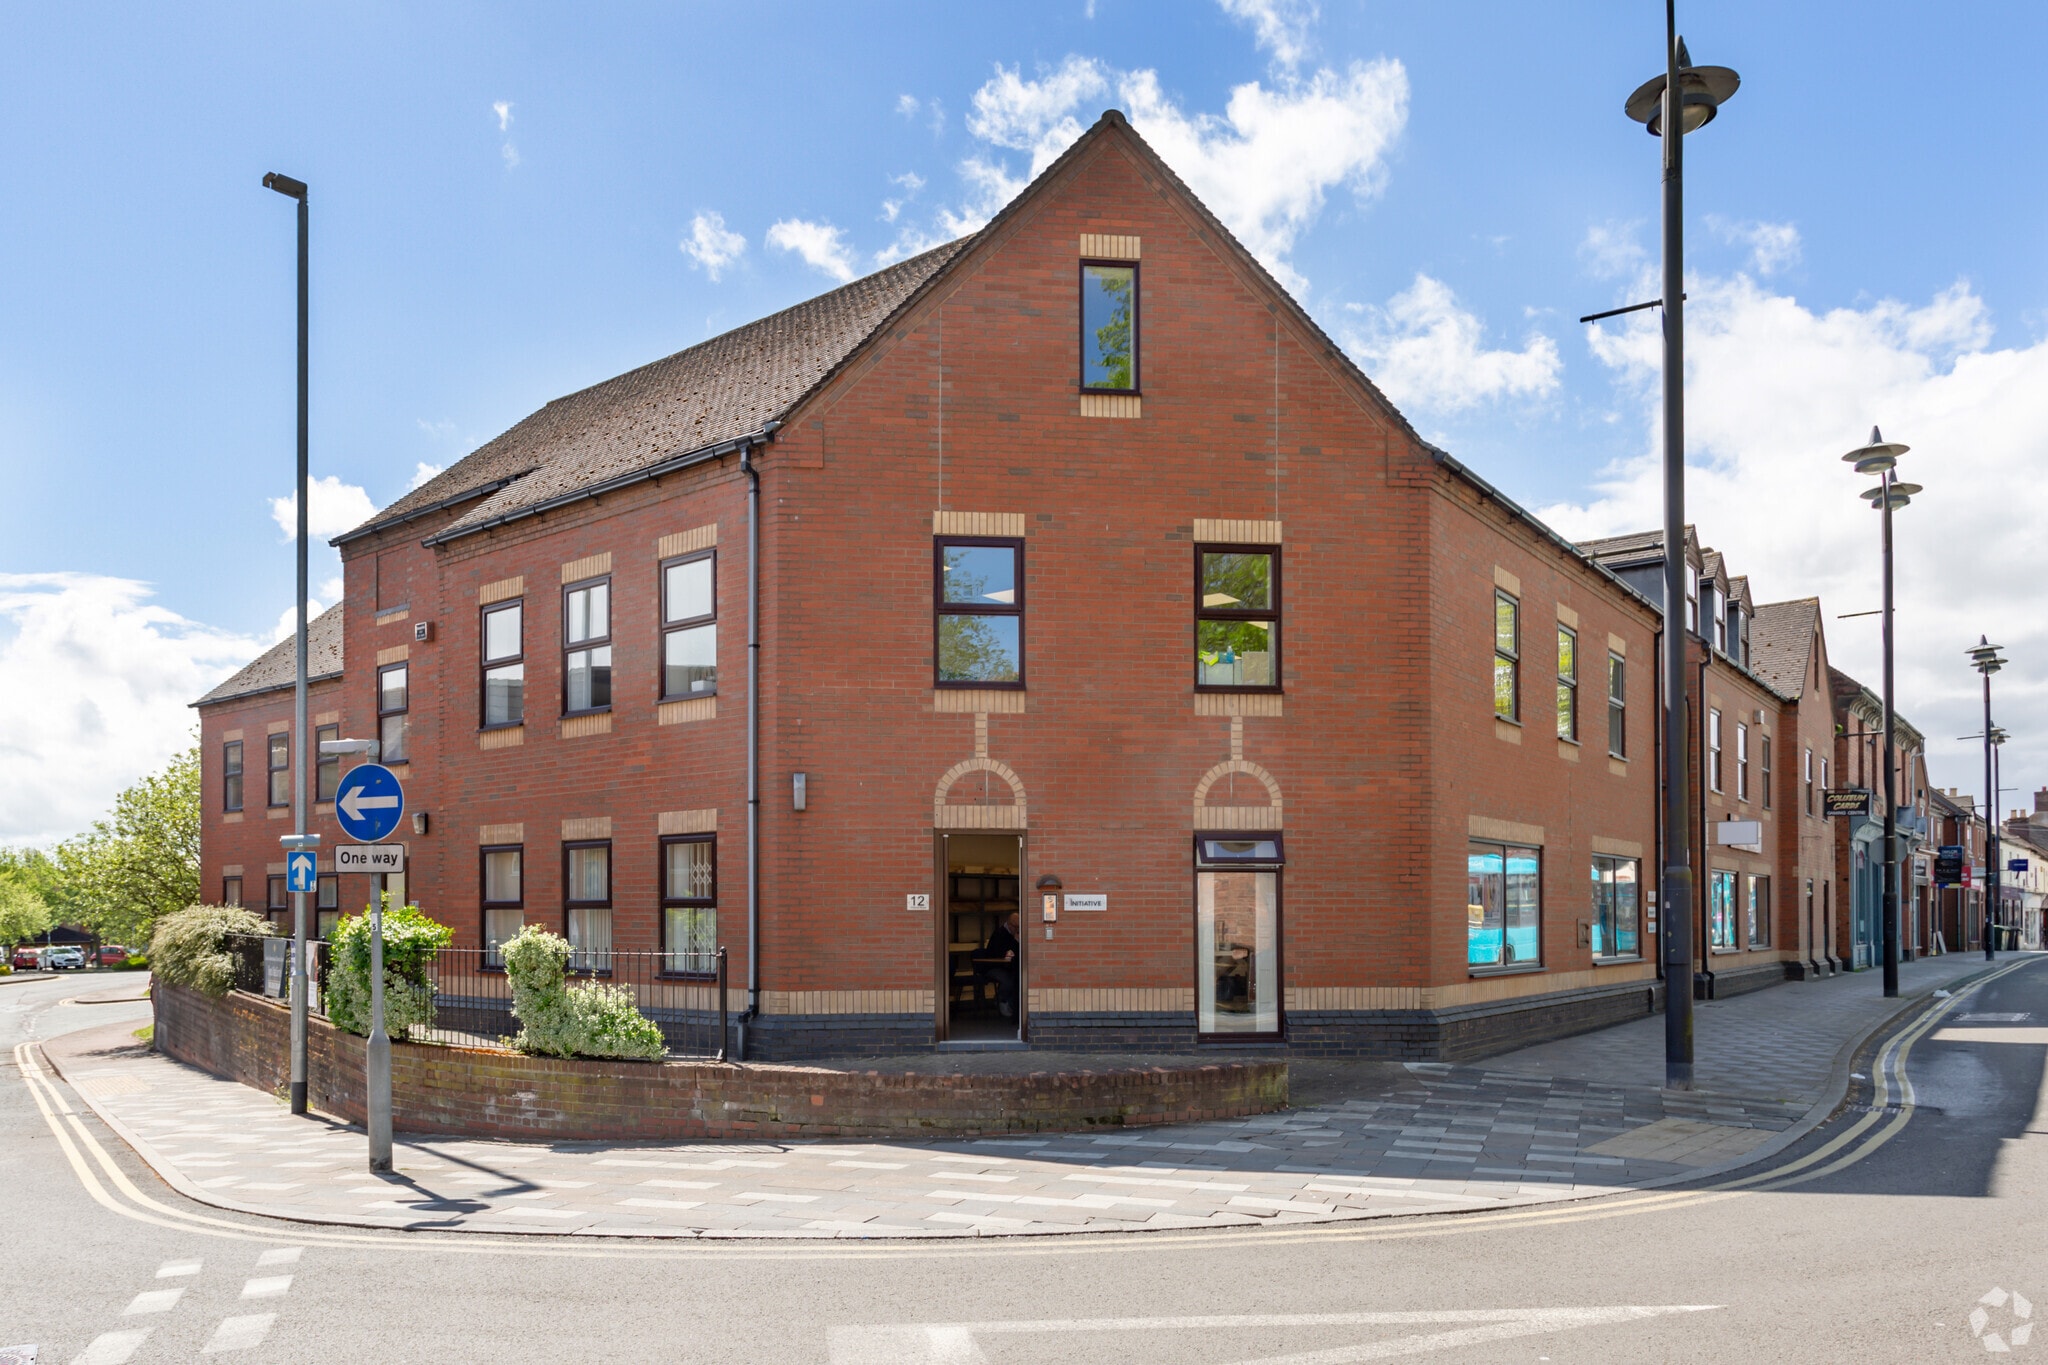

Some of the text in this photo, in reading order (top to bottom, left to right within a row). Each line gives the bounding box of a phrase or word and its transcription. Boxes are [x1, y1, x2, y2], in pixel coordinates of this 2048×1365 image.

[1833, 802, 1860, 810] CARDS
[340, 851, 398, 866] One way
[910, 895, 925, 906] 12
[1070, 898, 1102, 907] INITIATIVE
